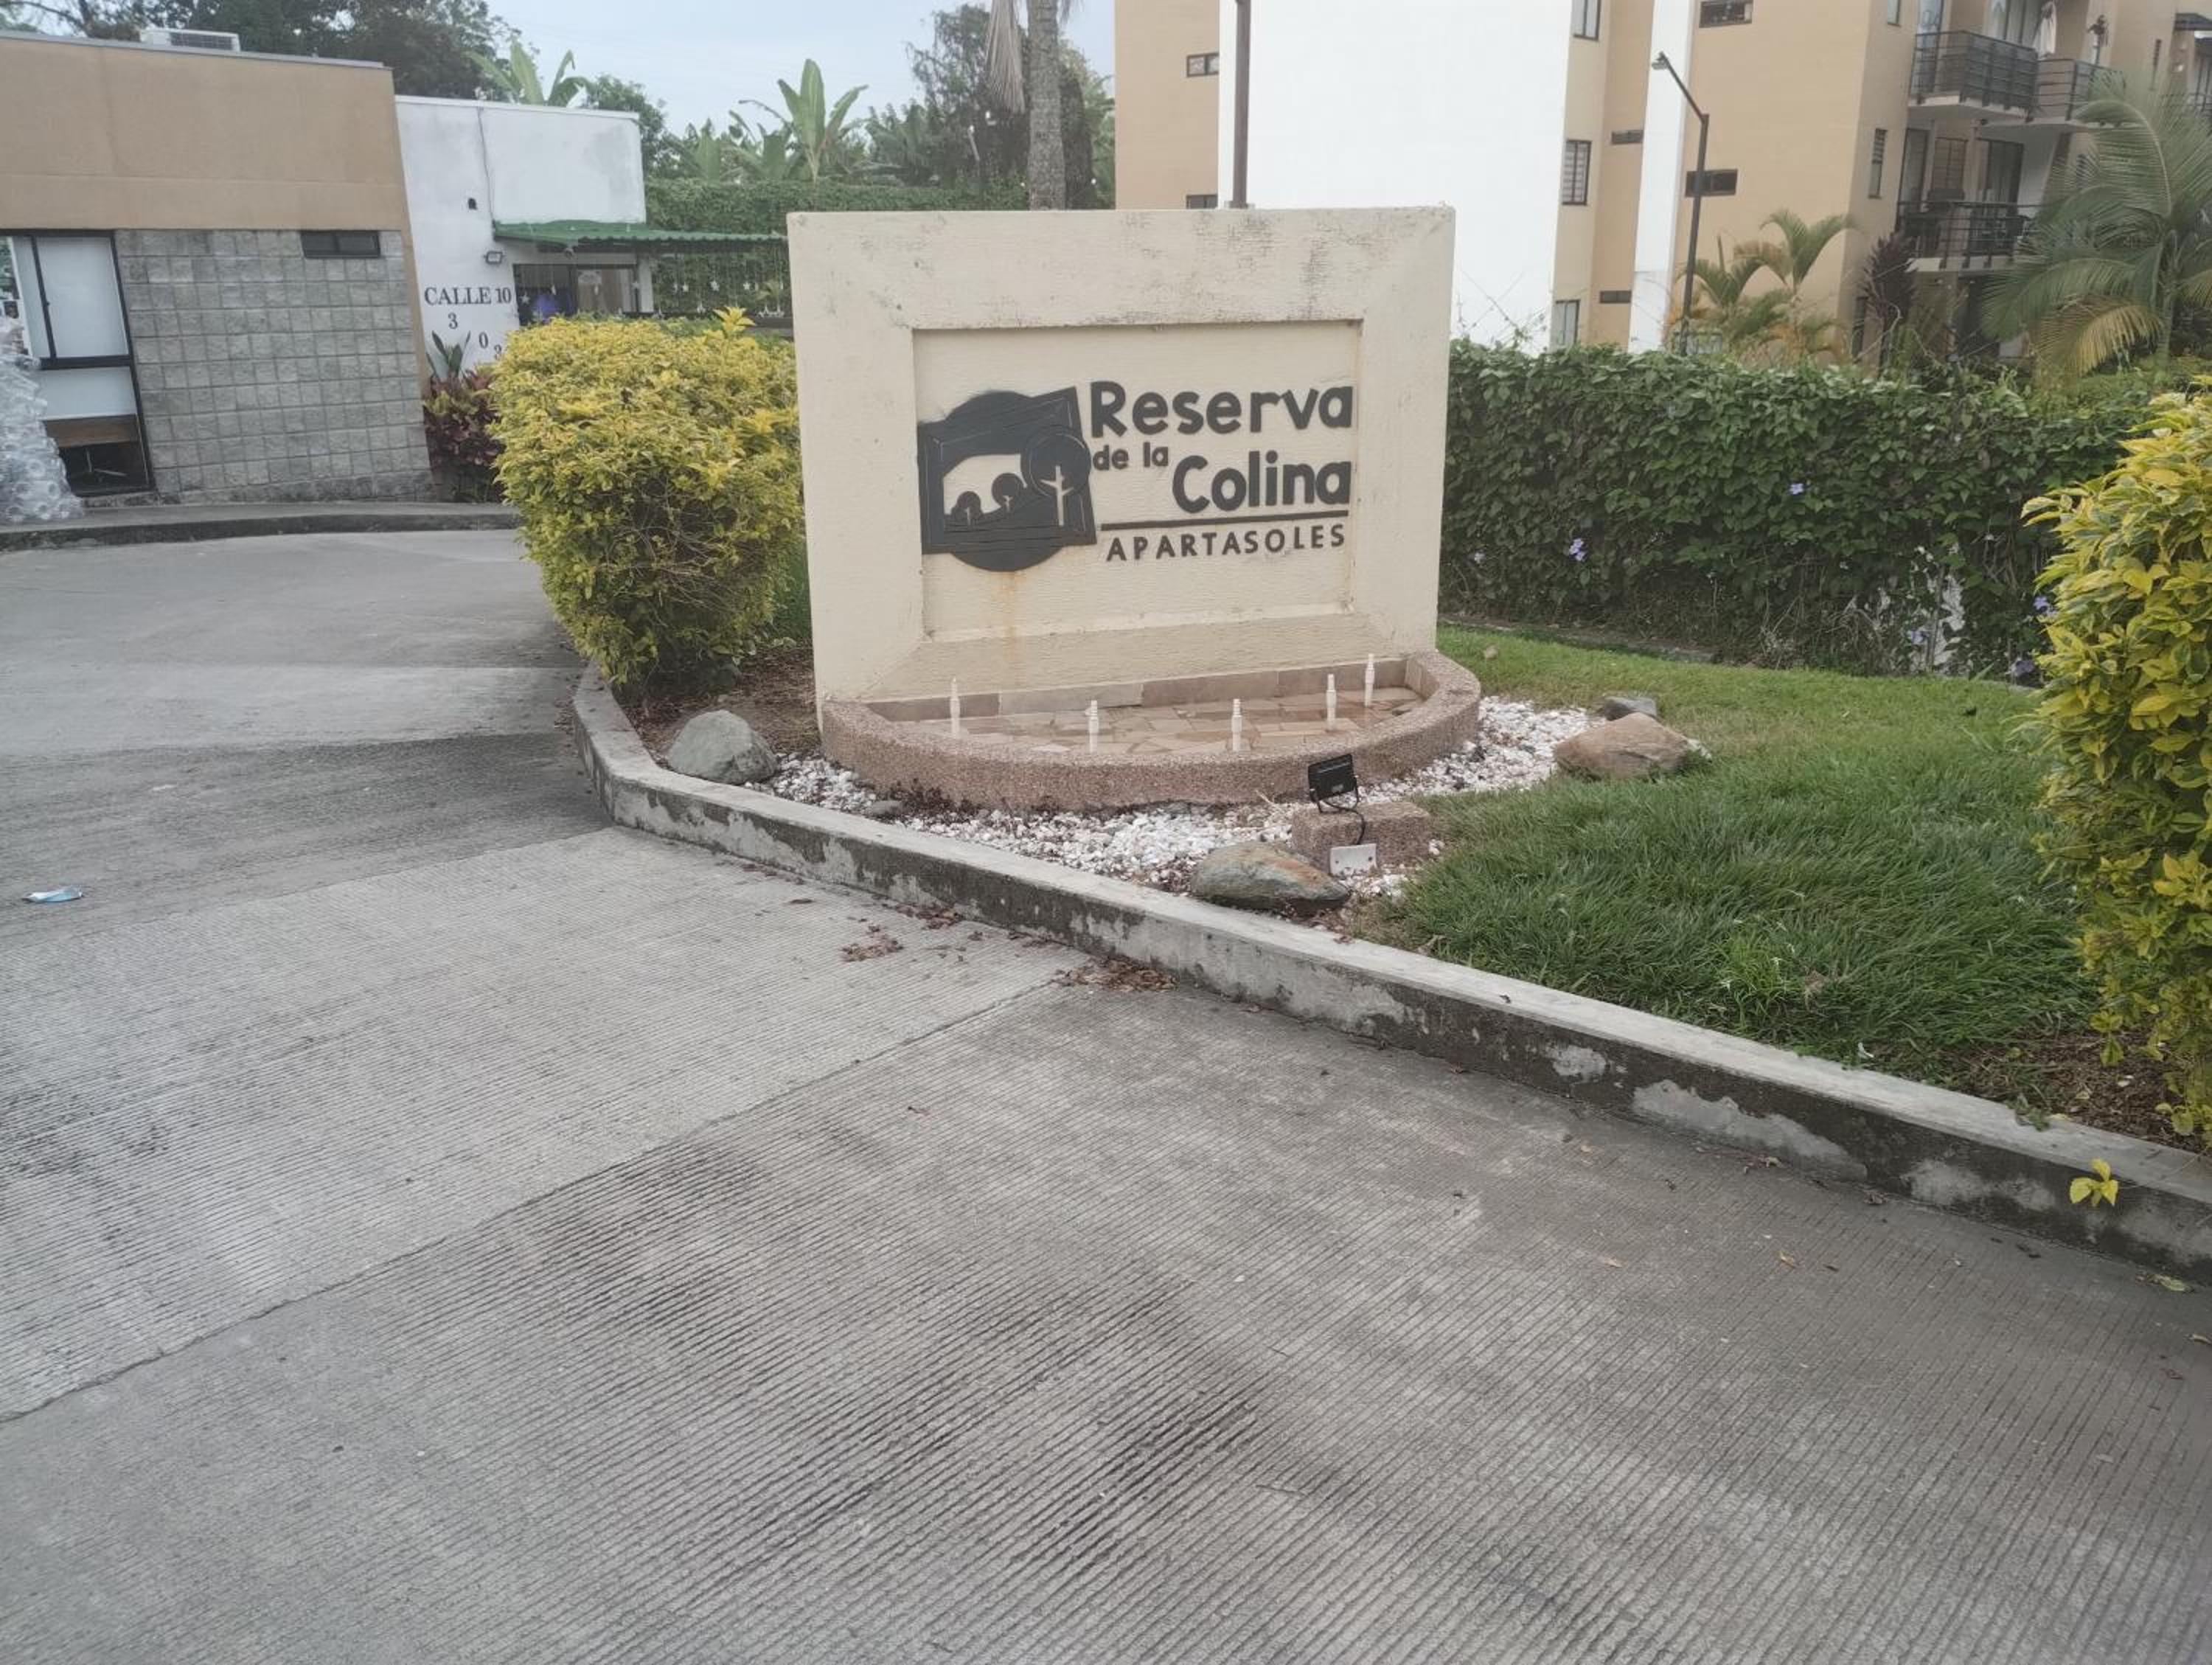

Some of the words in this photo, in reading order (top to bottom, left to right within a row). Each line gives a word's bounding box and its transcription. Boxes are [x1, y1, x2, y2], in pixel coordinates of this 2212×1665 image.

[424, 287, 491, 305] CALLE
[495, 287, 512, 304] 10
[1090, 380, 1353, 439] Reserva
[1093, 445, 1130, 471] de
[1143, 442, 1169, 467] la
[1172, 450, 1352, 514] Colina
[1106, 524, 1346, 562] APARTASOLES
